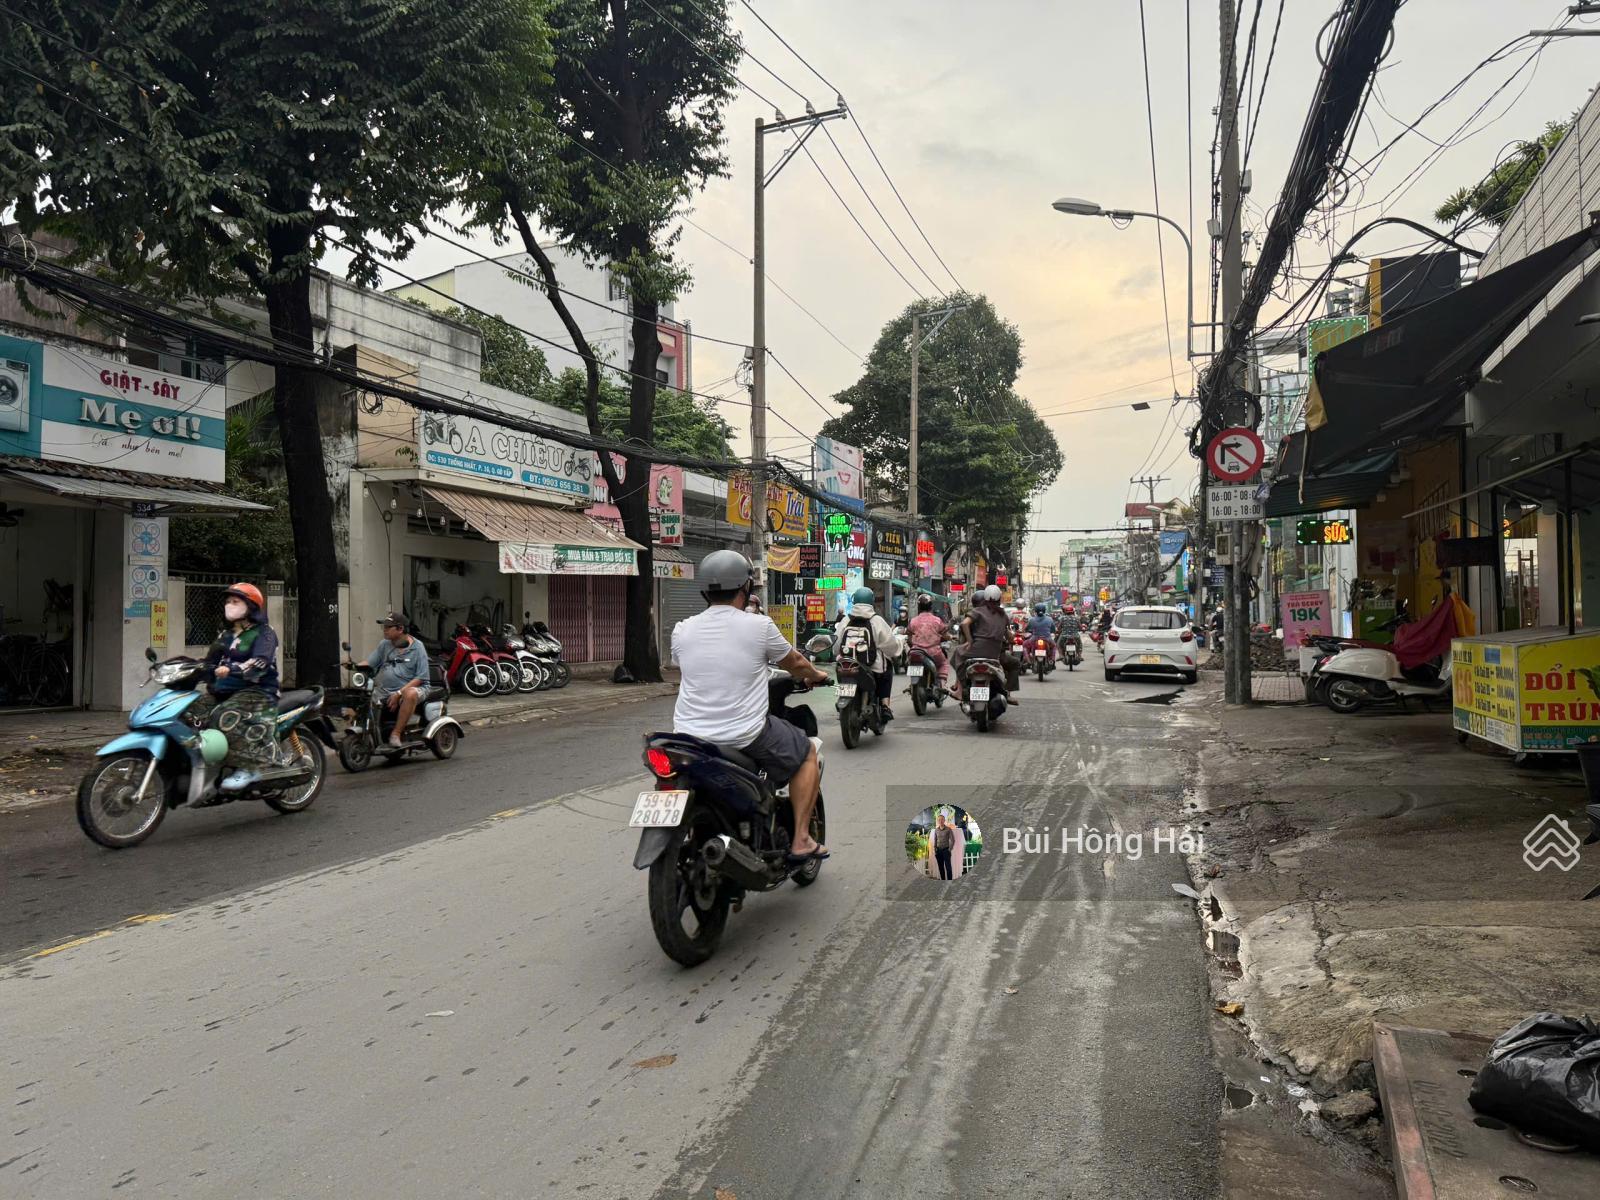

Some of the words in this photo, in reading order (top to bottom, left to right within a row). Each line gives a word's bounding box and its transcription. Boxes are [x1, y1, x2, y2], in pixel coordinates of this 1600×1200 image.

[100, 370, 142, 394] GIẶT
[153, 378, 181, 400] SẤY
[80, 397, 143, 434] Mẹ
[465, 426, 485, 455] A
[1211, 491, 1232, 502] 06:00
[1240, 489, 1258, 501] 08:0
[1212, 505, 1232, 517] 16:00
[1240, 504, 1261, 515] 18:00
[1289, 607, 1321, 622] 19K
[1524, 663, 1577, 691] ĐỔI
